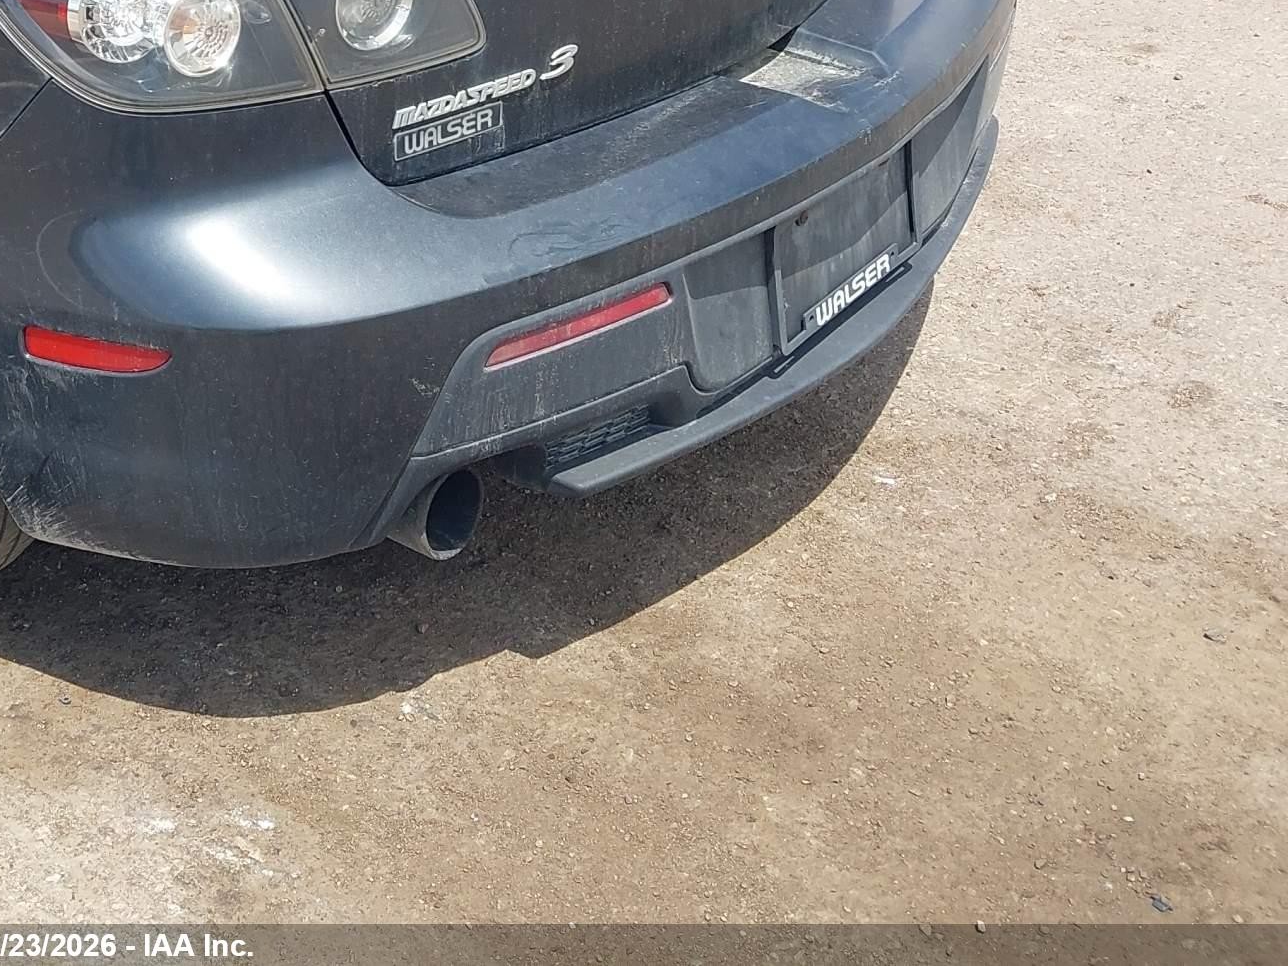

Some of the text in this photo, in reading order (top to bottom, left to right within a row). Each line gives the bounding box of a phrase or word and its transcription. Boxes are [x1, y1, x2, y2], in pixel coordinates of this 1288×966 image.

[392, 44, 579, 129] MAZDASPEED 3
[404, 109, 492, 154] WALSER
[815, 254, 891, 326] WALSER
